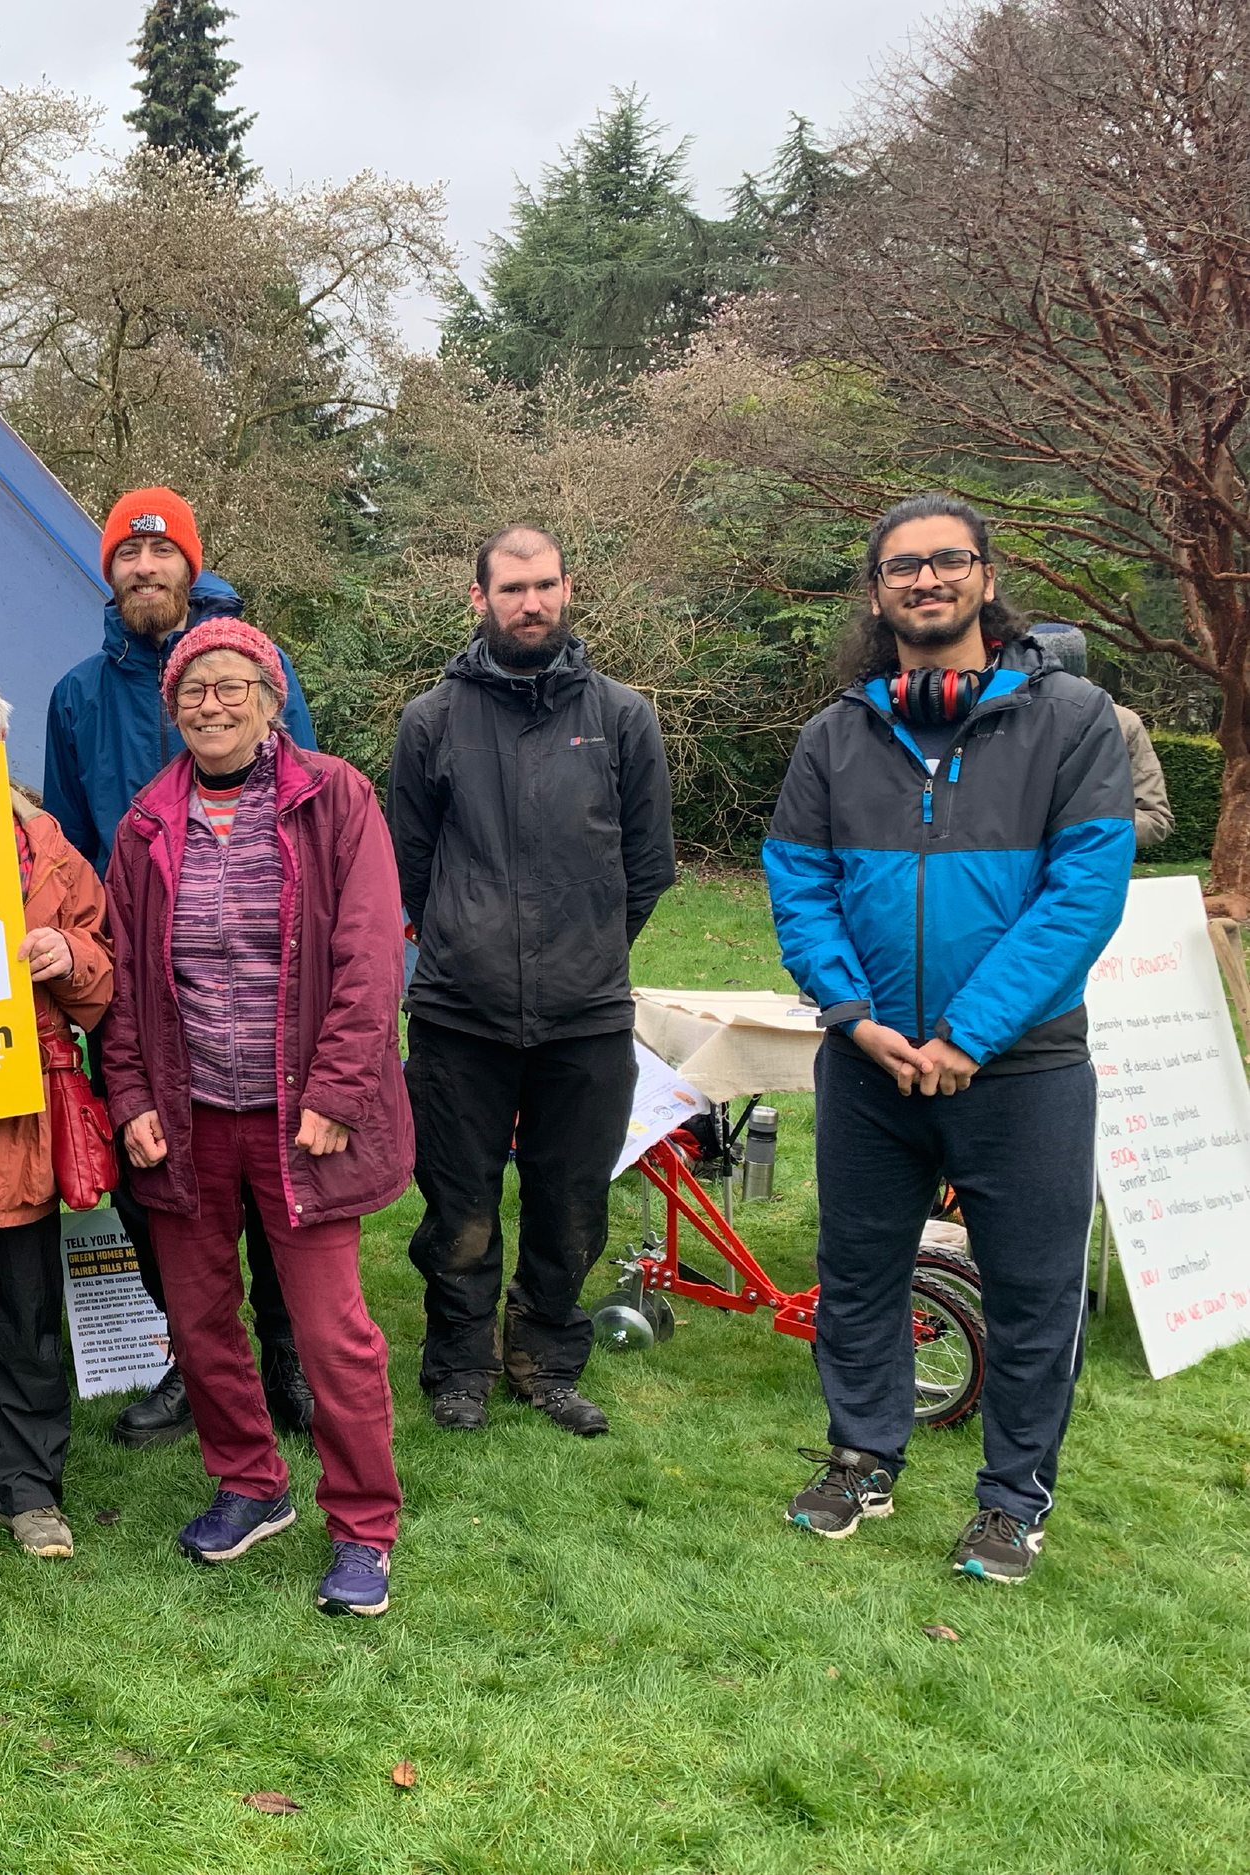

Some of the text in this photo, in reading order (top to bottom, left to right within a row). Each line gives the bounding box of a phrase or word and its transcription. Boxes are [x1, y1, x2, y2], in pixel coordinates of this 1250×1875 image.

[1125, 1115, 1147, 1133] 250
[1148, 1165, 1171, 1182] 2022
[1147, 1198, 1163, 1220] 20
[64, 1233, 130, 1249] TELL YOUR M
[68, 1252, 94, 1263] GREEN
[96, 1249, 124, 1260] HOMES
[70, 1261, 139, 1277] FAIRER BILLS FOR
[1166, 1309, 1187, 1332] CAN
